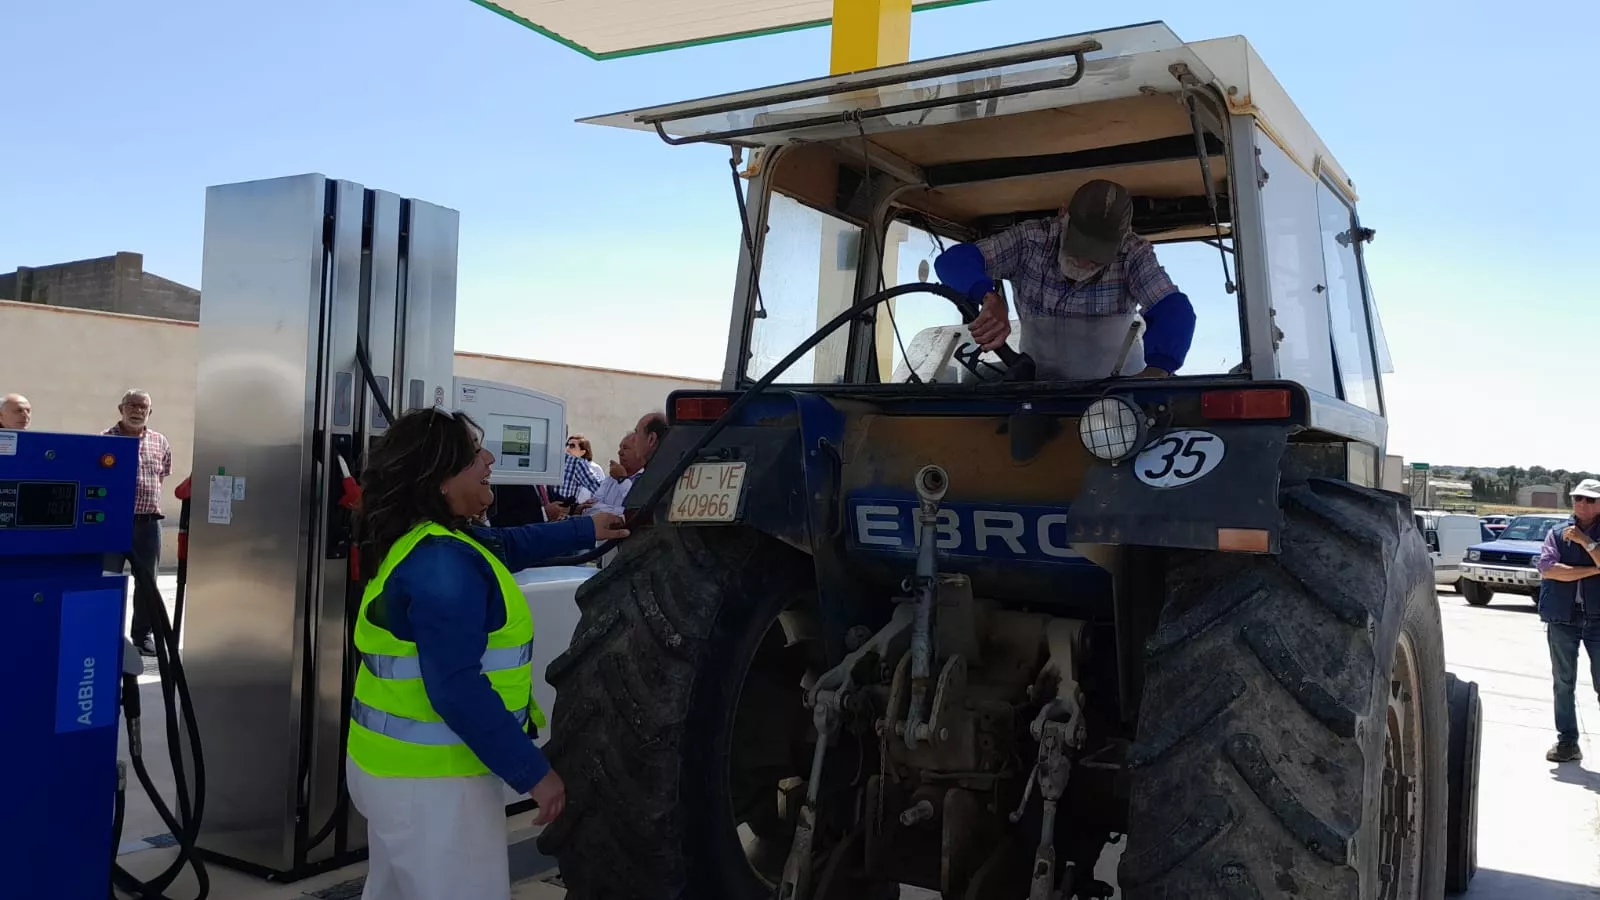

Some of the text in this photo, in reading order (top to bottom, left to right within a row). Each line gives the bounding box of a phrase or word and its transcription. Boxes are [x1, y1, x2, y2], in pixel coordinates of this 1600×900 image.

[1144, 436, 1213, 479] 35
[678, 466, 704, 490] HU
[719, 465, 745, 490] VE
[676, 493, 730, 517] 40966
[76, 656, 96, 725] AdBlue
